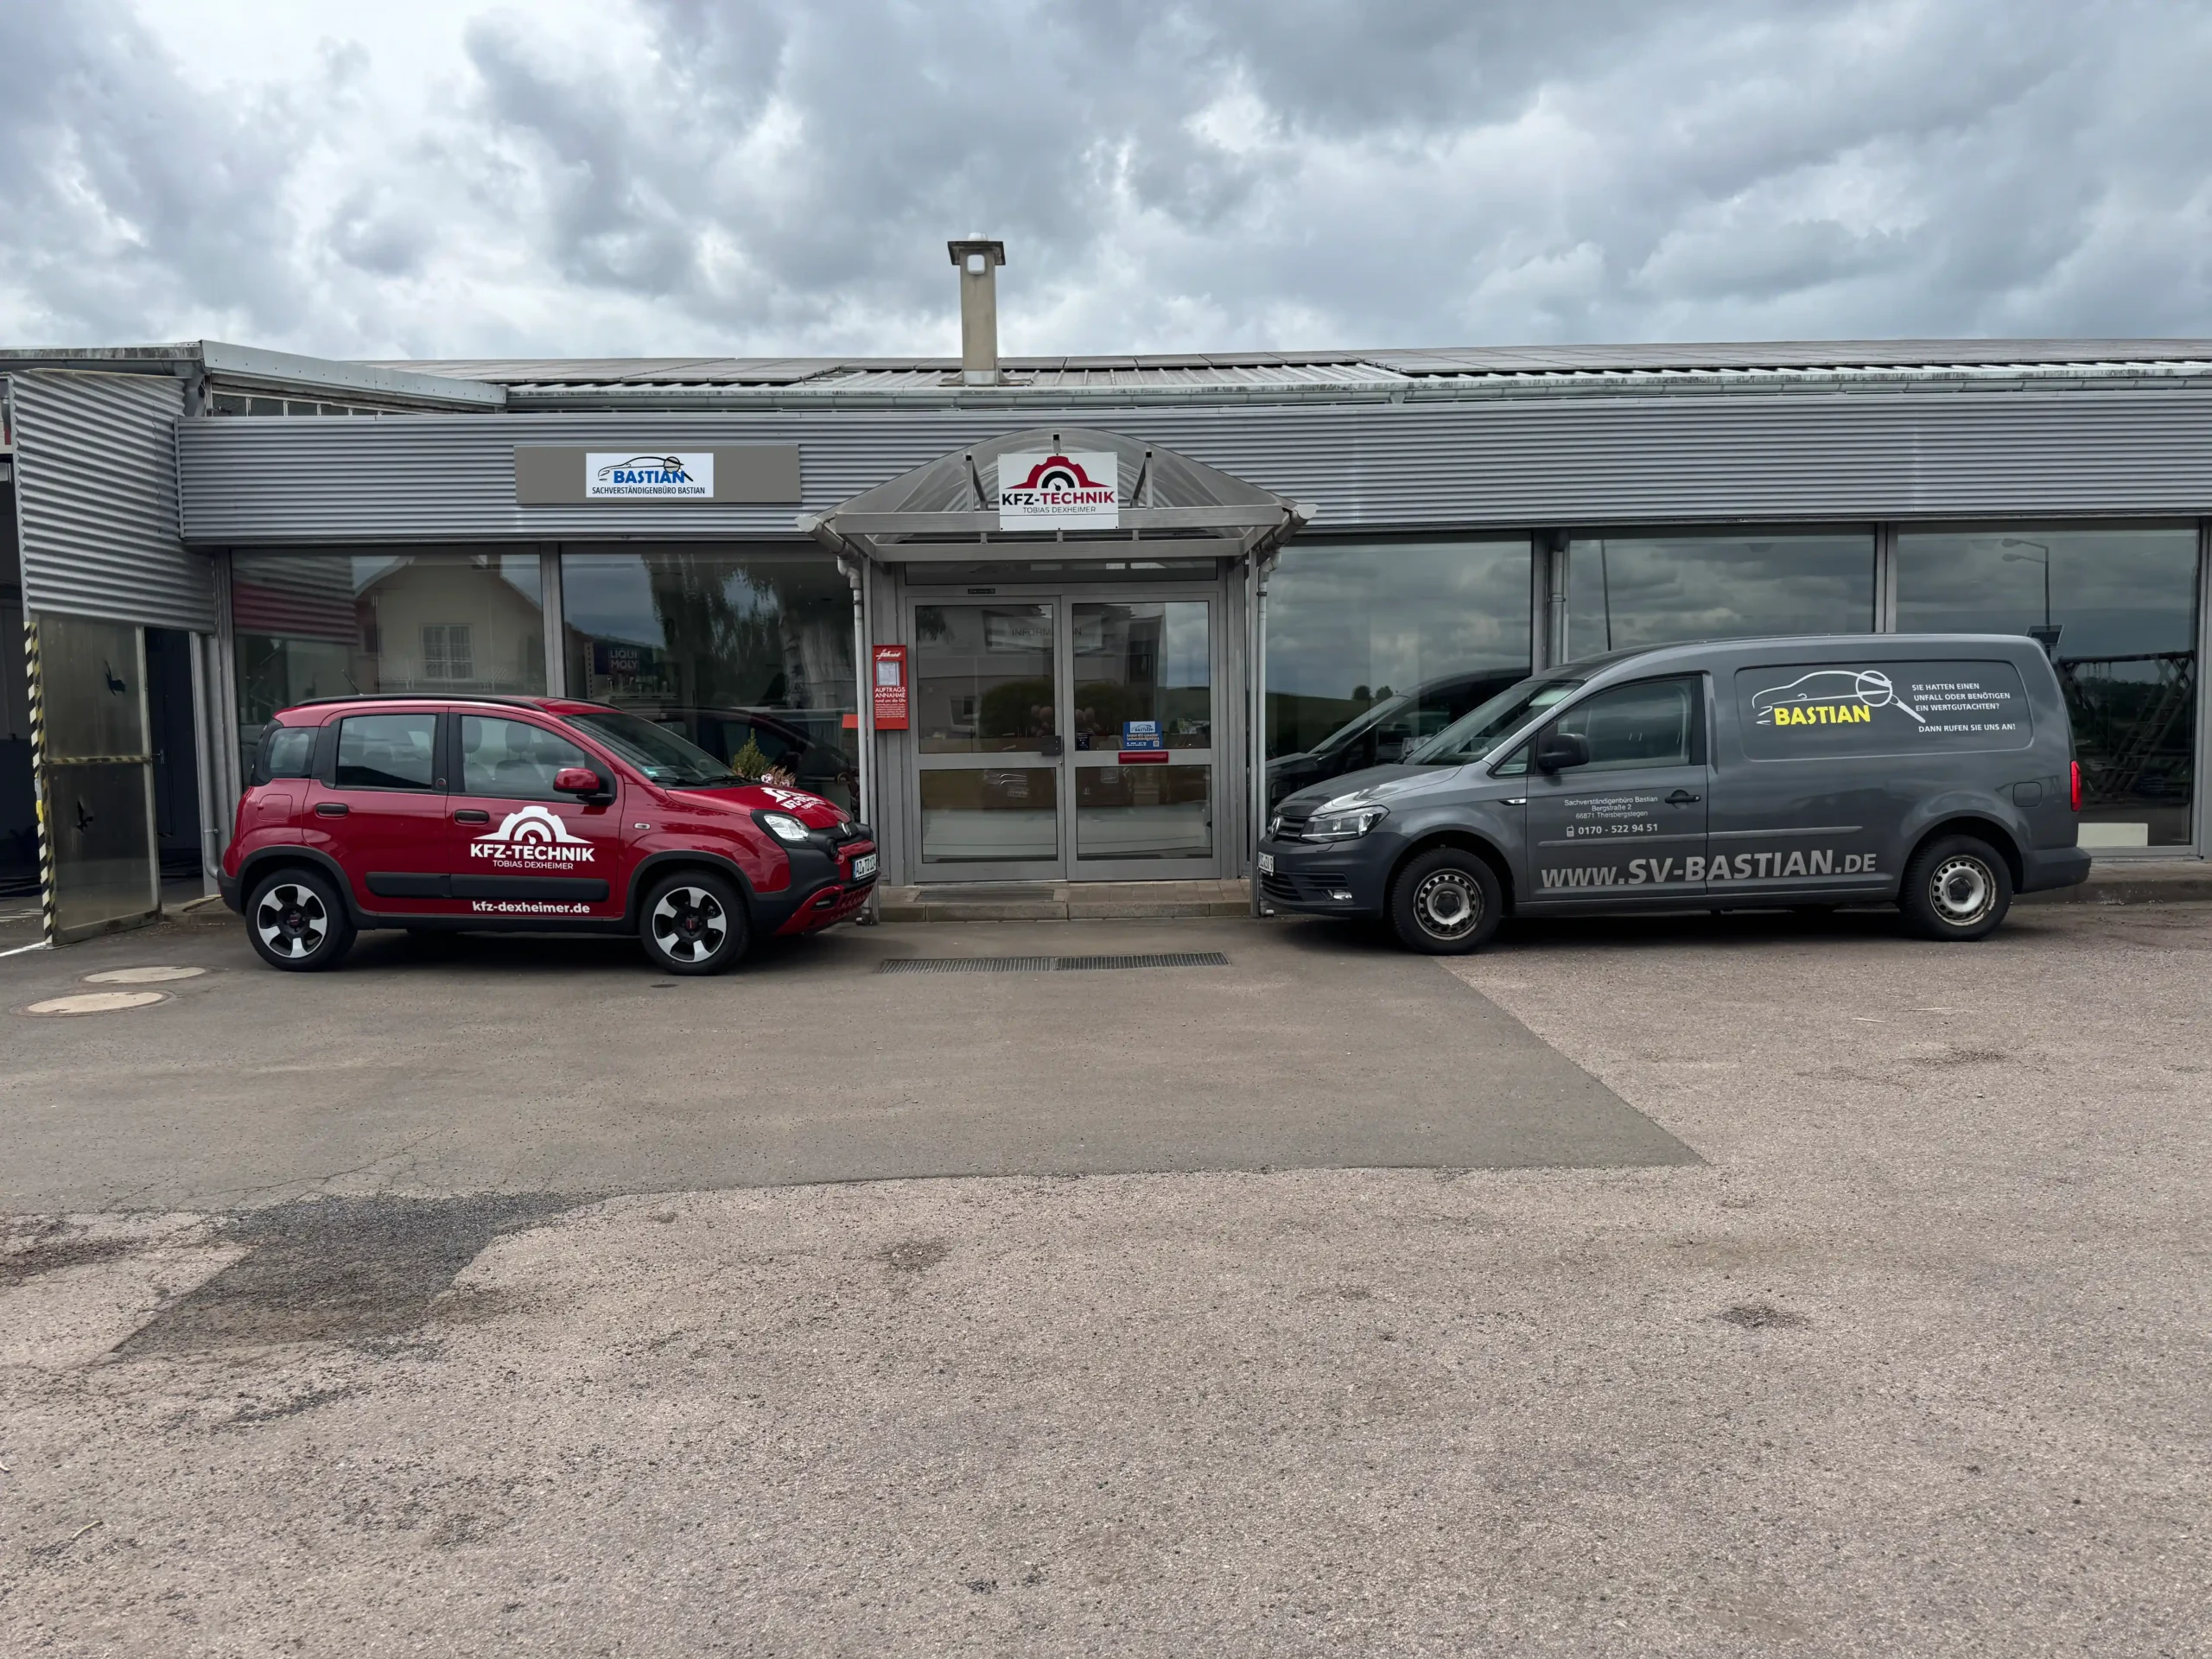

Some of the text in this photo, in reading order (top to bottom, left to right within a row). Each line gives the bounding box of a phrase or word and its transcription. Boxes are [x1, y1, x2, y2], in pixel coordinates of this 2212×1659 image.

[613, 470, 684, 484] BASTIAN
[592, 486, 676, 494] SACHVERSTÄNDIGENBÜRO
[1002, 491, 1115, 505] KFZ-TECHNIK
[1012, 627, 1082, 636] INFORMN
[610, 649, 638, 658] LIQUI
[610, 660, 638, 669] MOLY
[1967, 691, 2011, 700] BENÖTIGEN
[1773, 705, 1871, 725] BASTIAN
[1564, 797, 1633, 806] Sachverständigenbüro
[1578, 826, 1602, 835] 0170
[1611, 824, 1629, 833] 522
[470, 843, 595, 861] KFZ-TECHNIK
[524, 861, 574, 869] DEXHEIMER
[473, 901, 590, 913] kfz-dexheimer.de
